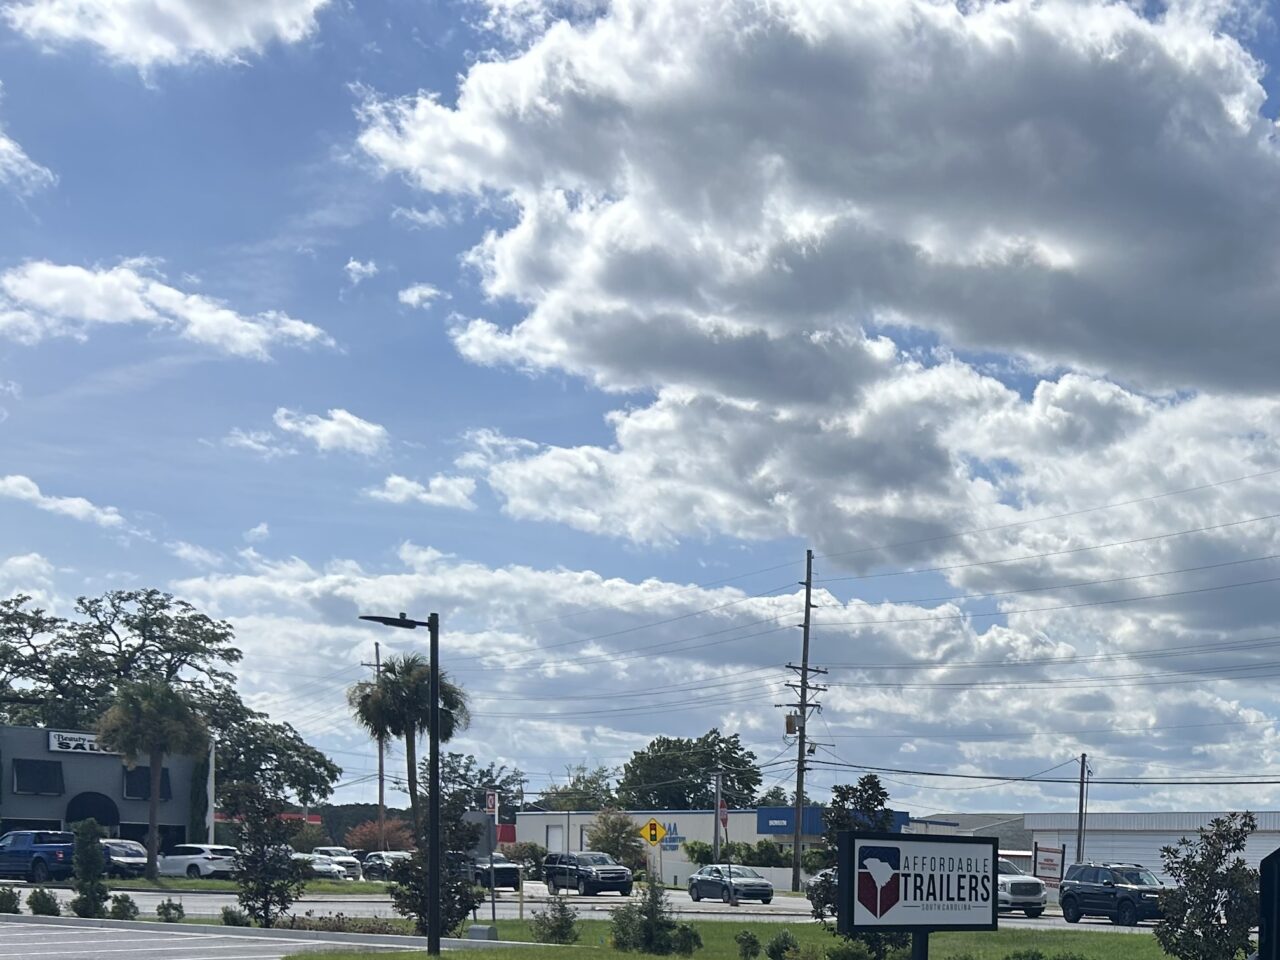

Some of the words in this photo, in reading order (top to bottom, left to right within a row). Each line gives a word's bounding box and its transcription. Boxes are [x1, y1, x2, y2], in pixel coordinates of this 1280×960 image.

[903, 855, 989, 873] AFFORDABLE
[901, 872, 991, 902] TRAILERS
[921, 903, 941, 911] SOUTH
[941, 903, 972, 911] CAROLINA
